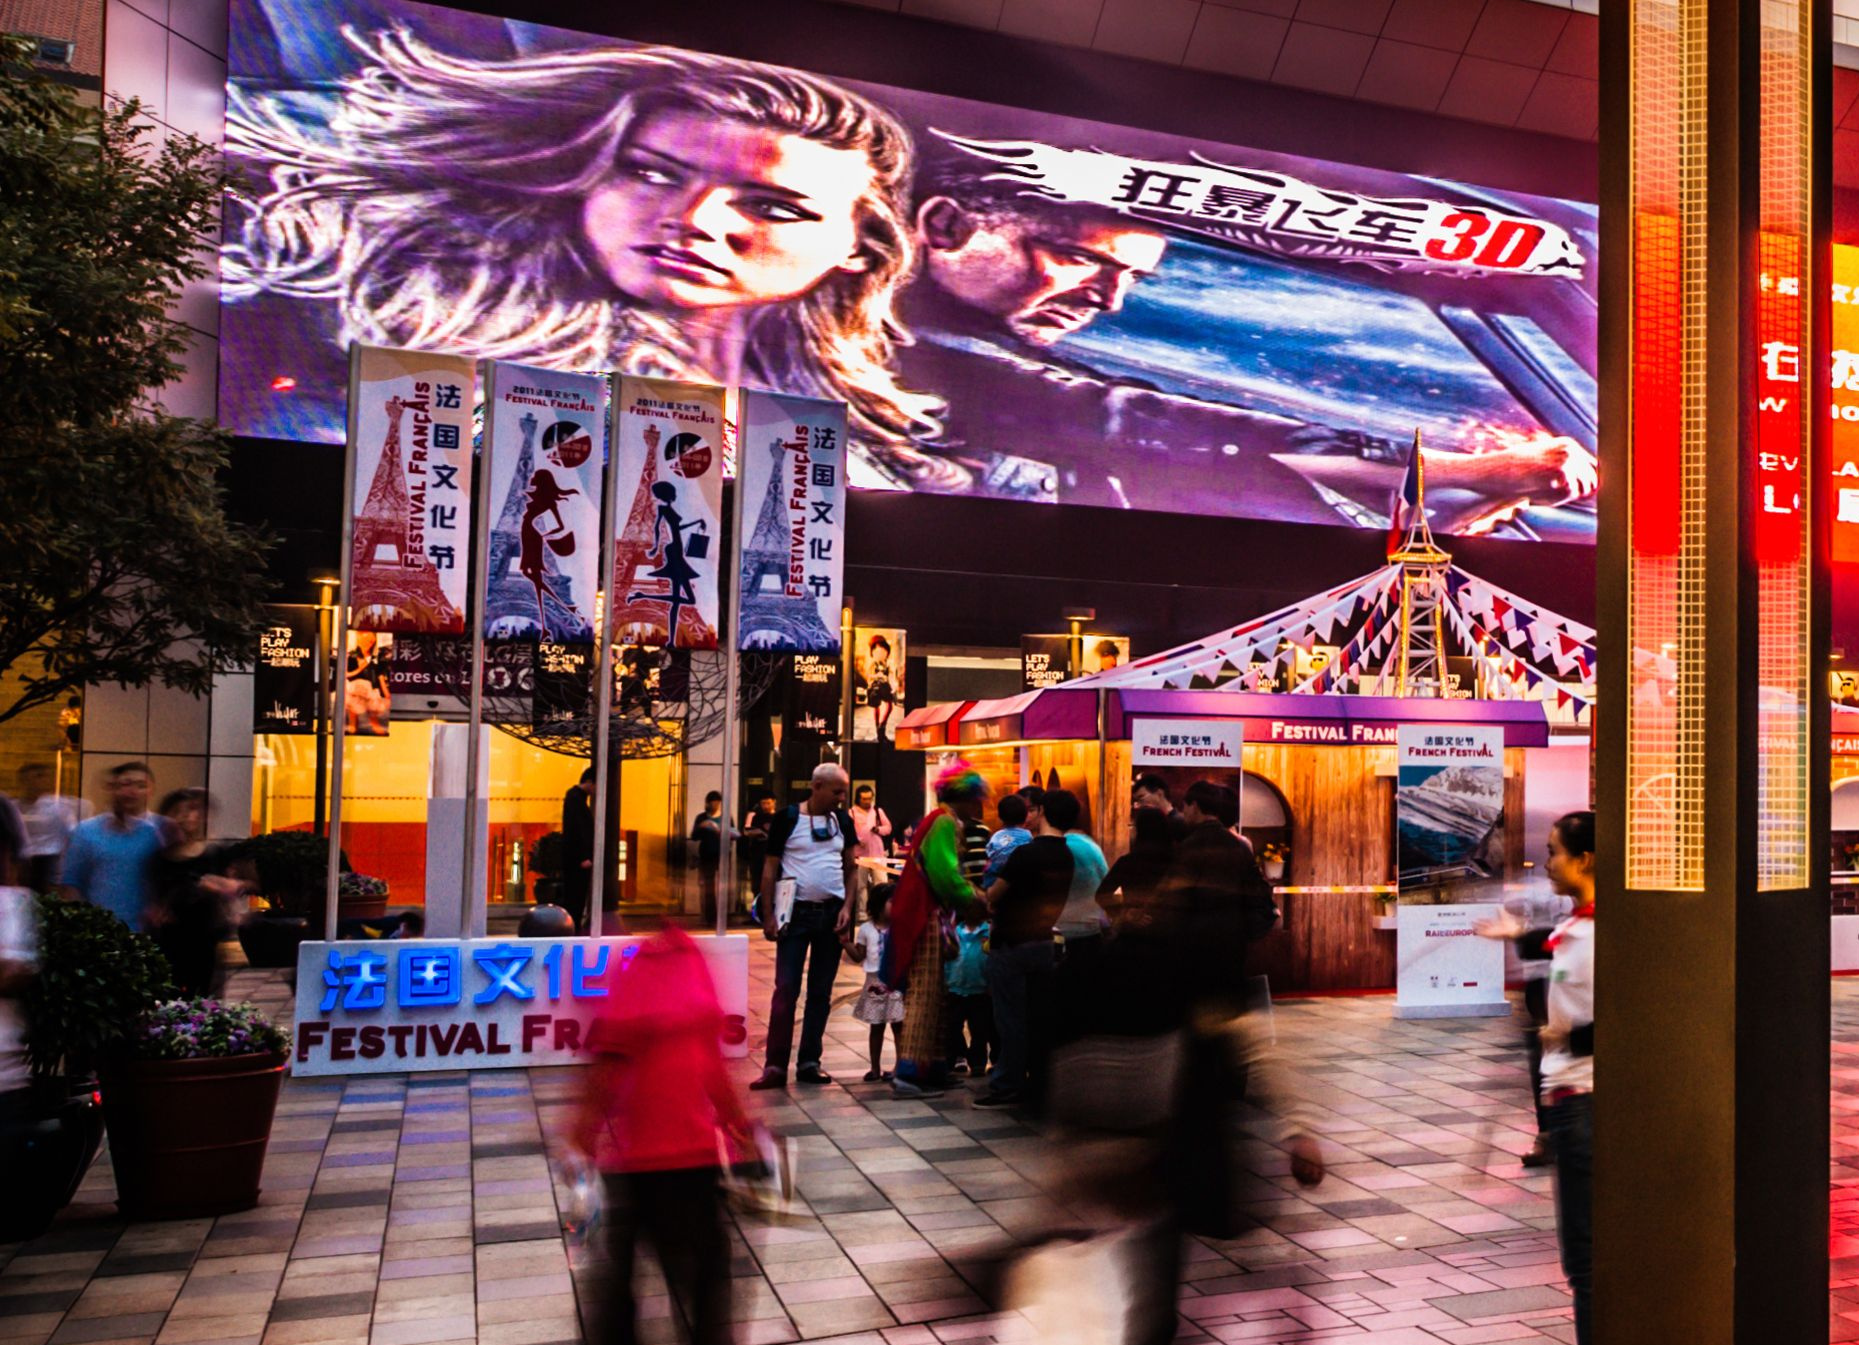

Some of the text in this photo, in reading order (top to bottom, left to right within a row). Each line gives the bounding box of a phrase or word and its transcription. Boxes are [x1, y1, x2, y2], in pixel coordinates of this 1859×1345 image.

[1112, 167, 1546, 268] 狂暴飞车 3D
[429, 384, 461, 570] 法国文化节
[404, 479, 427, 570] FESTIVAL
[808, 427, 836, 598] 法国文化节
[786, 516, 806, 597] FESTIVAL
[260, 647, 311, 659] FASHION
[390, 670, 431, 684] ores
[1143, 742, 1232, 758] FRENCH FESTIVAL
[1271, 721, 1398, 742] FESTIVAL FRAN
[1408, 742, 1494, 758] FRENCH FESTIVAL
[320, 943, 640, 1012] 法国文化
[298, 1020, 511, 1062] FESTIVAL
